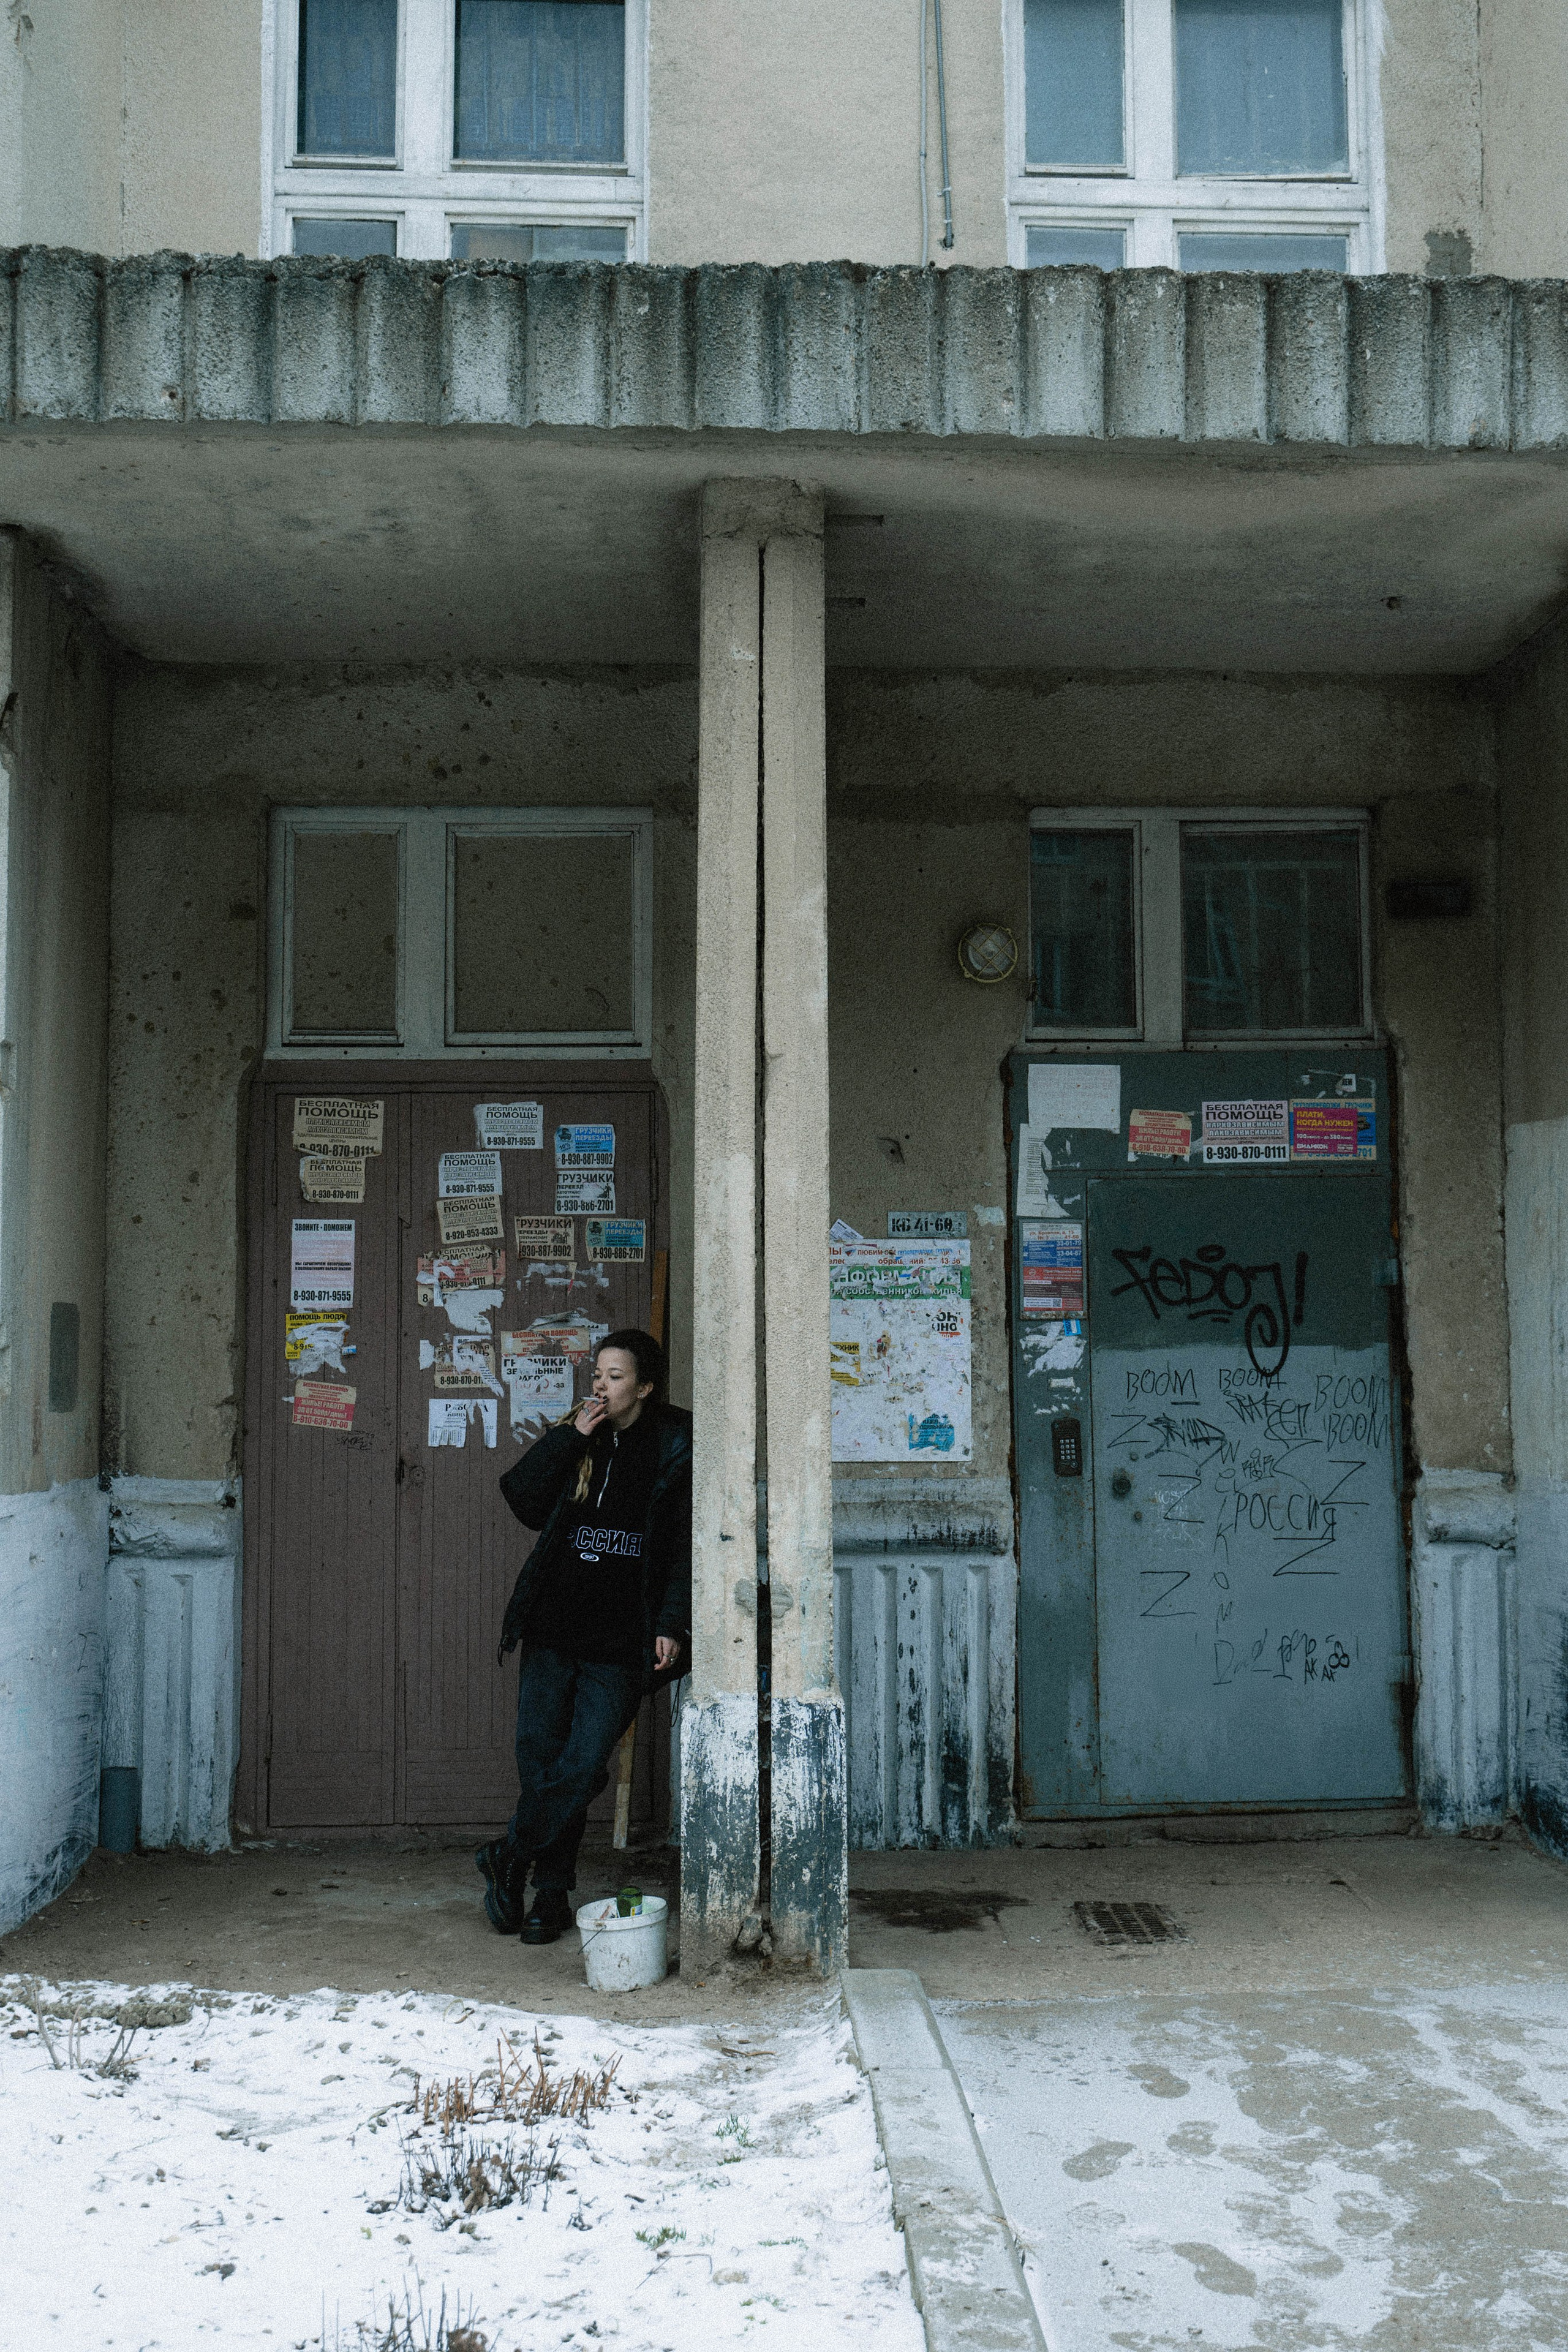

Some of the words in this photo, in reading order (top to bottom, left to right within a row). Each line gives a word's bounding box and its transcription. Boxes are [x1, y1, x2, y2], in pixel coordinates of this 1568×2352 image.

[299, 1100, 379, 1109] БЕСПЛАТНАЯ
[298, 1107, 379, 1120] ПОМОЩЬ
[1206, 1110, 1284, 1120] ПОМОЩЬ
[487, 1137, 535, 1145] 8-930-871-9555
[1206, 1145, 1286, 1159] 8-930-870-0111
[444, 1158, 496, 1167] ПОМОЩЬ
[561, 1153, 613, 1166] 8-930-887-9902
[557, 1174, 613, 1183] ГРУЗЧИКИ
[312, 1189, 359, 1199] 8-930-870-0111
[446, 1183, 495, 1194] 8-930-871-9555
[444, 1196, 494, 1207] БЕСПЛАТНАЯ
[444, 1202, 496, 1213] ПОМОЩЬ
[295, 1223, 320, 1232] ЗВОНИТЕ
[323, 1223, 352, 1232] ПОМОЖЕМ
[516, 1218, 571, 1229] ГРУЗЧИКИ
[445, 1226, 499, 1241] 8-920-953-4333
[440, 1246, 485, 1255] ЕСПЛАТНАЯ
[519, 1245, 571, 1257] -930-887-9902
[592, 1247, 644, 1259] 8-930-886-2701
[293, 1291, 352, 1301] 8-930-871-9555
[512, 1330, 551, 1339] БЕСПЛАТАЯ
[503, 1358, 567, 1367] ГРЧИКИ
[1235, 1493, 1337, 1541] РОССИЯ
[575, 1526, 643, 1556] ССИЯ
